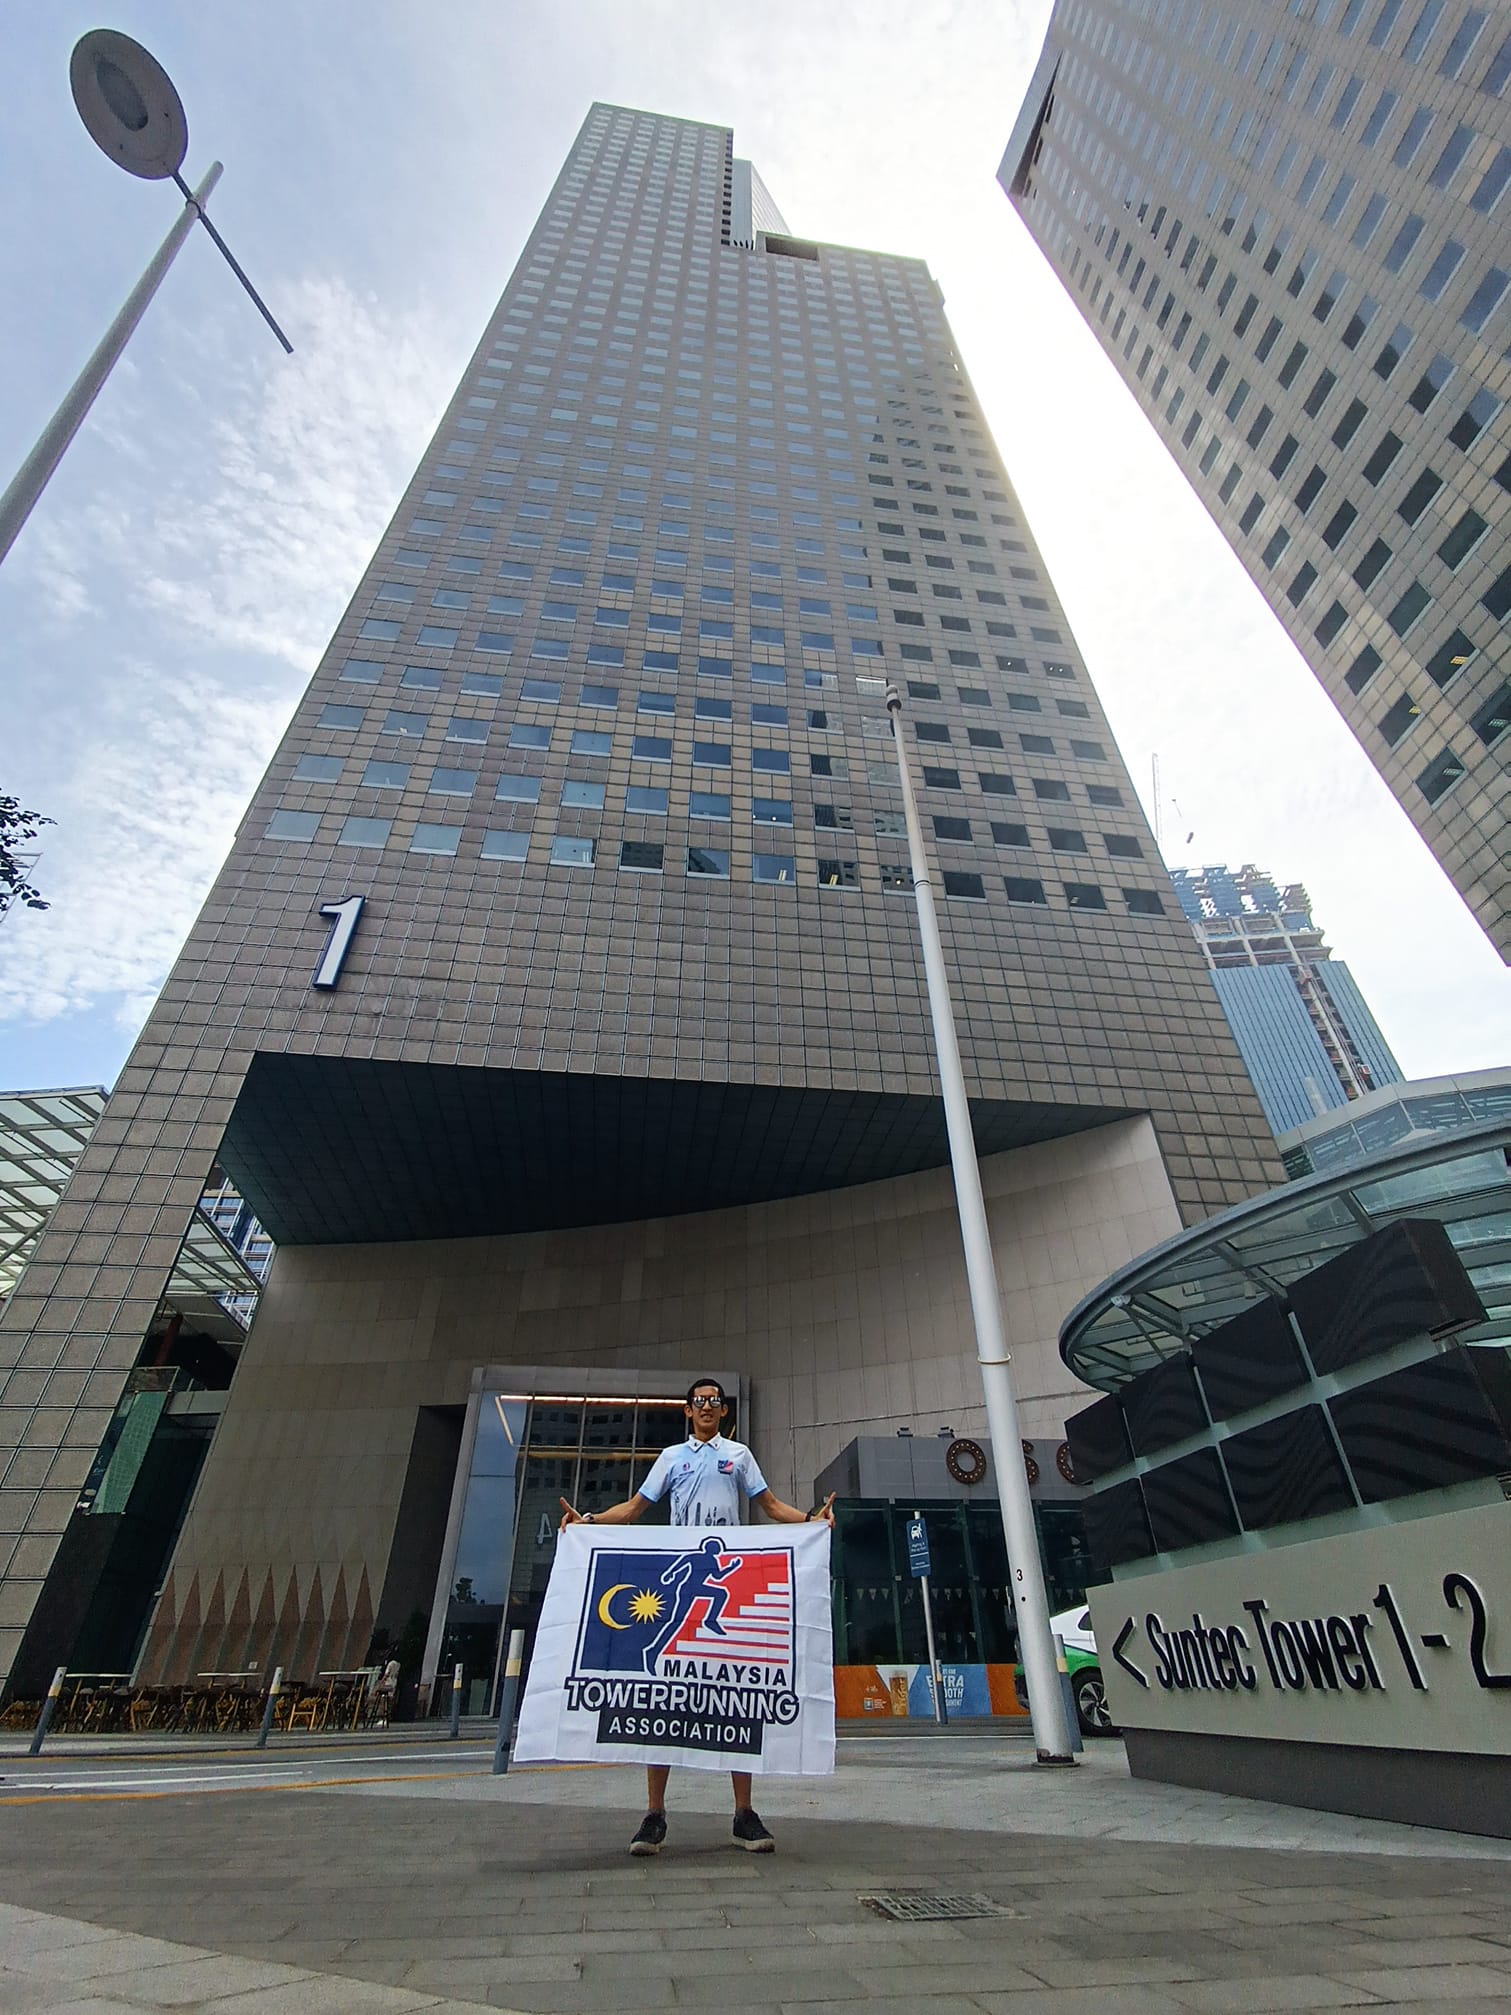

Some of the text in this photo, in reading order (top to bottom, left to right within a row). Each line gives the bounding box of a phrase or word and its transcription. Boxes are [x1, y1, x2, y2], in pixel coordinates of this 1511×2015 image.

[312, 894, 366, 990] 1
[1016, 1568, 1023, 1581] 3
[1145, 1612, 1257, 1690] Suntec
[1243, 1599, 1387, 1691] Tower
[663, 1658, 788, 1687] MALAYSIA
[564, 1677, 799, 1725] TOWERRUNNING
[608, 1715, 751, 1745] ASSOCIATION
